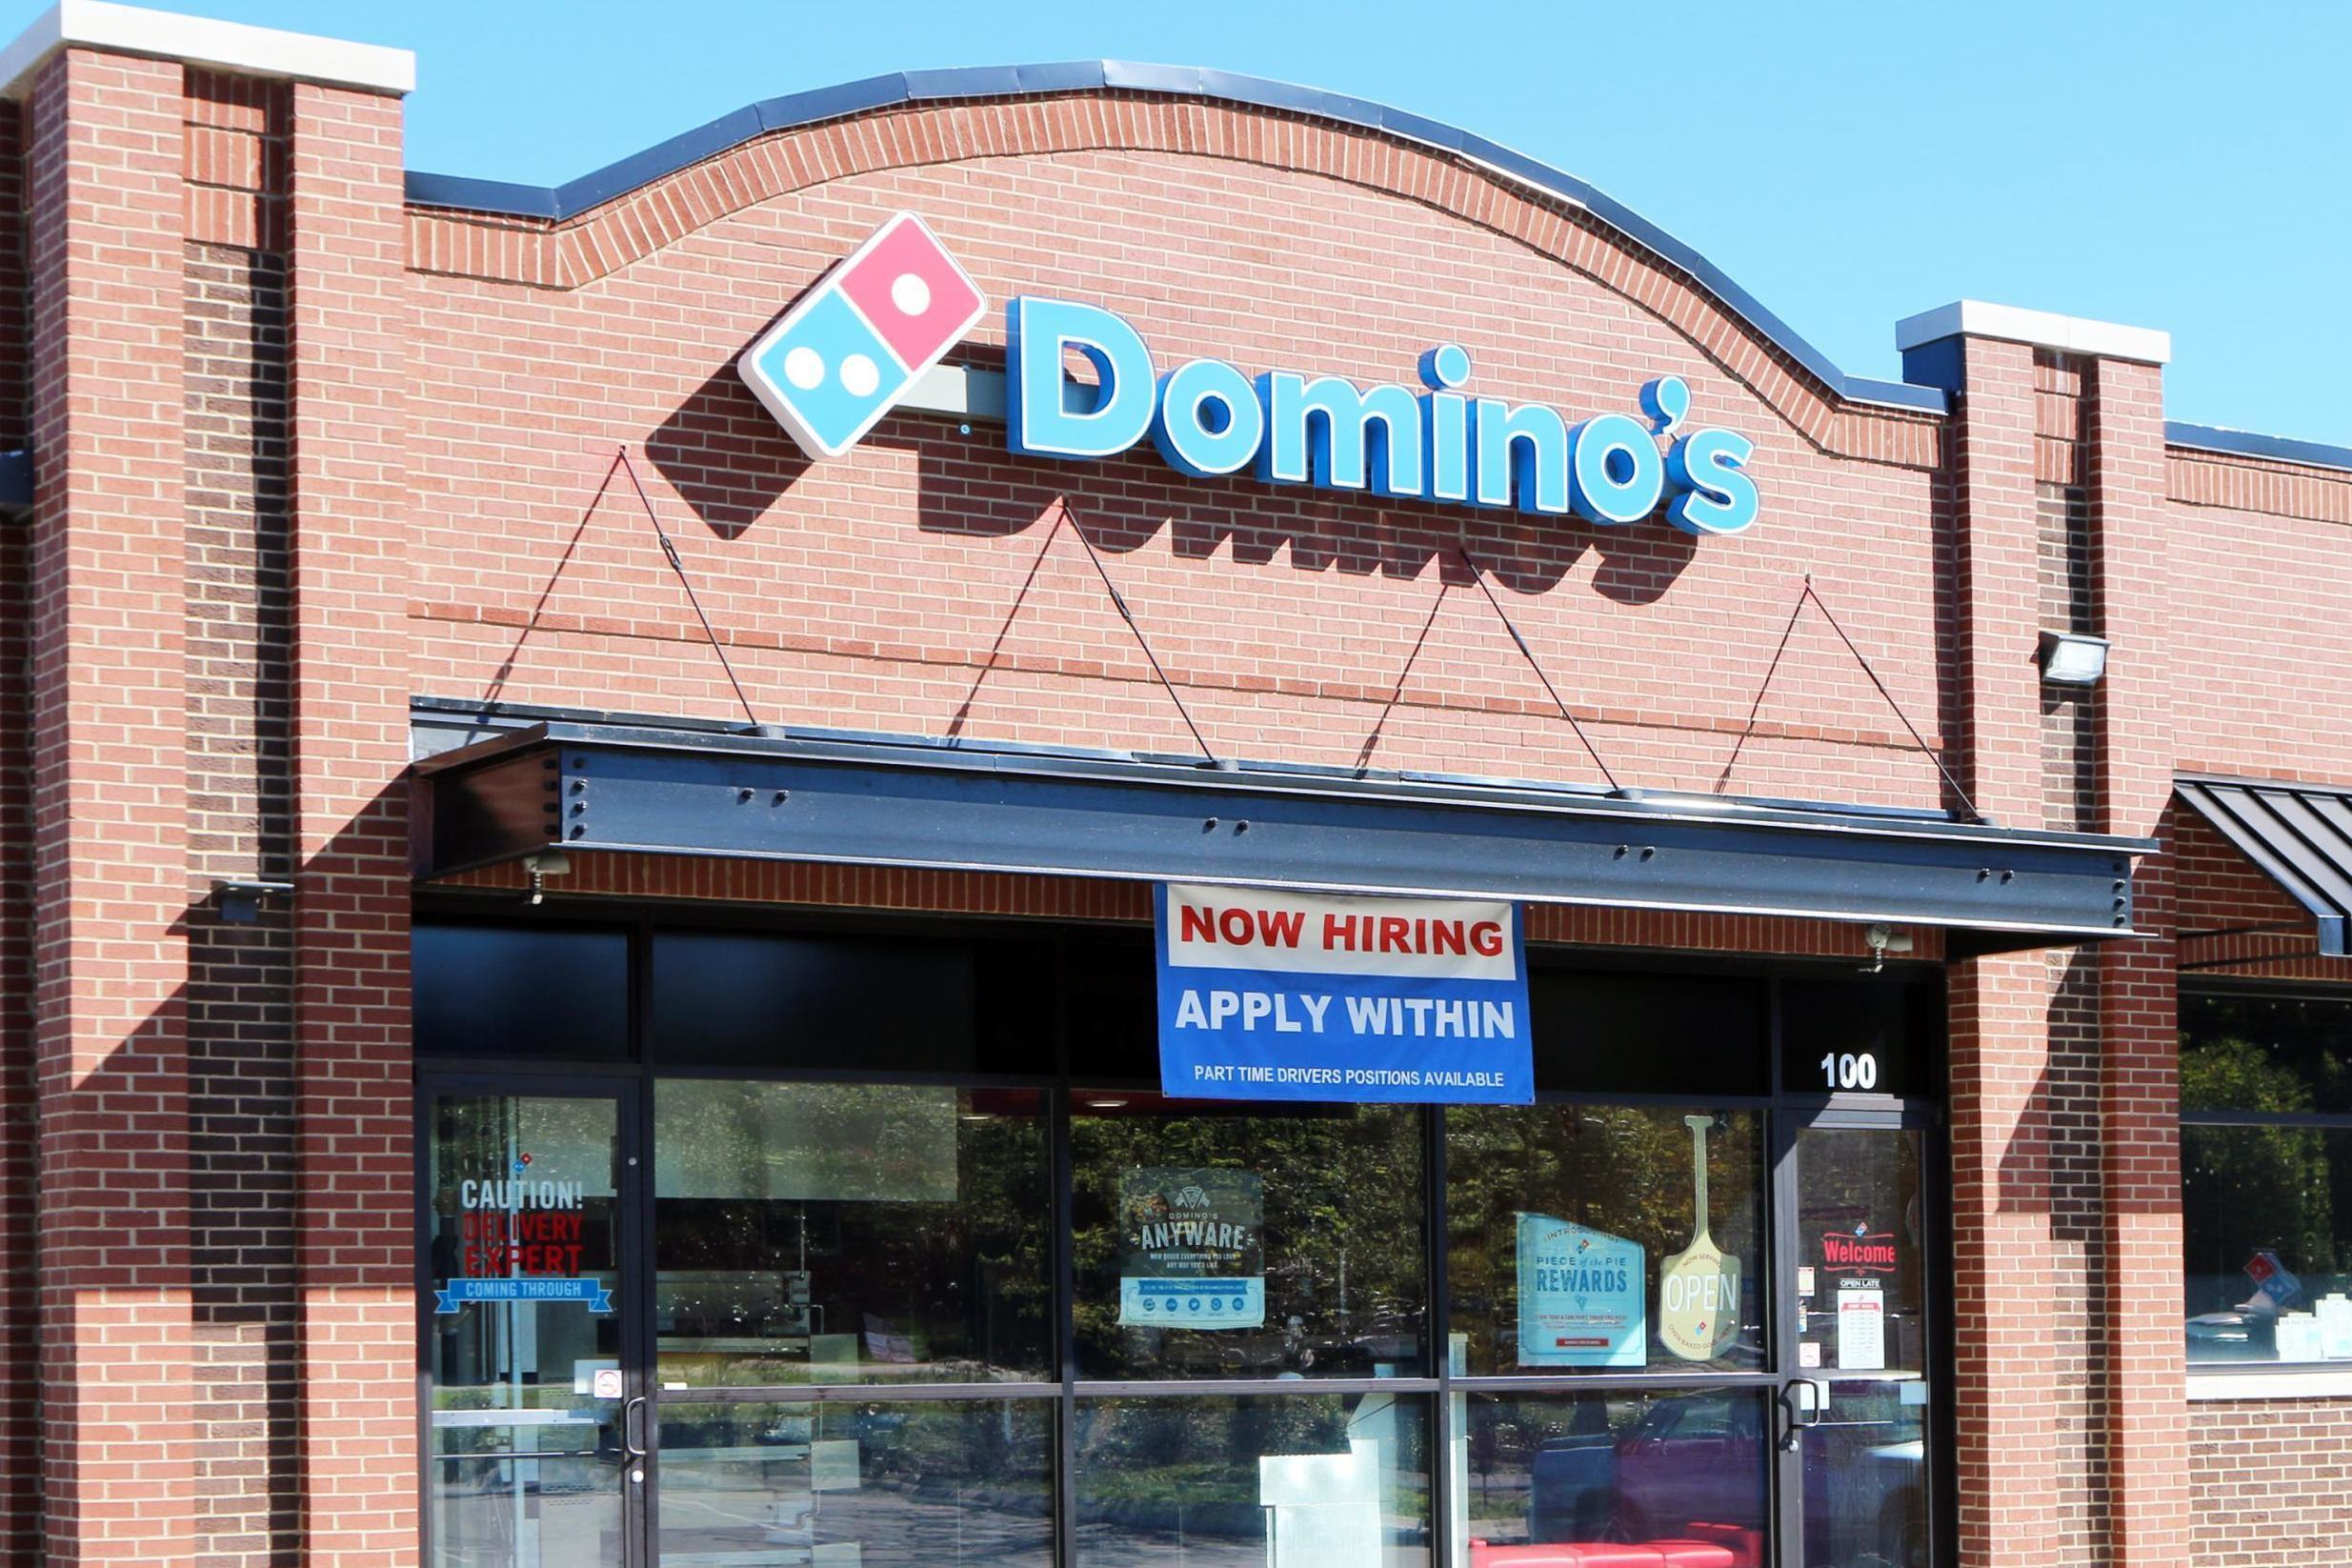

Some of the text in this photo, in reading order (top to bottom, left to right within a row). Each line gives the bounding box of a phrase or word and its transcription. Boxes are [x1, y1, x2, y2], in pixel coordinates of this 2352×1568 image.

[1007, 295, 1760, 535] Domino's
[1180, 905, 1503, 957] NOW HIRING
[1175, 990, 1516, 1039] APPLY WITHIN
[1194, 1064, 1504, 1088] PART TIME DRIVERS POSITIONS AVAILABLE
[1820, 1053, 1877, 1090] 100
[461, 1179, 583, 1210] CAUTION!
[463, 1212, 584, 1241] DELIVERY
[1141, 1220, 1246, 1251] ANYWARE
[464, 1245, 584, 1277] EXPERT
[1537, 1256, 1577, 1266] PIECE
[1606, 1257, 1627, 1267] PIE
[1823, 1240, 1895, 1264] Welcome
[465, 1281, 582, 1297] COMING THROUGH
[1537, 1269, 1628, 1293] REWARDS
[1666, 1273, 1737, 1312] OPEN
